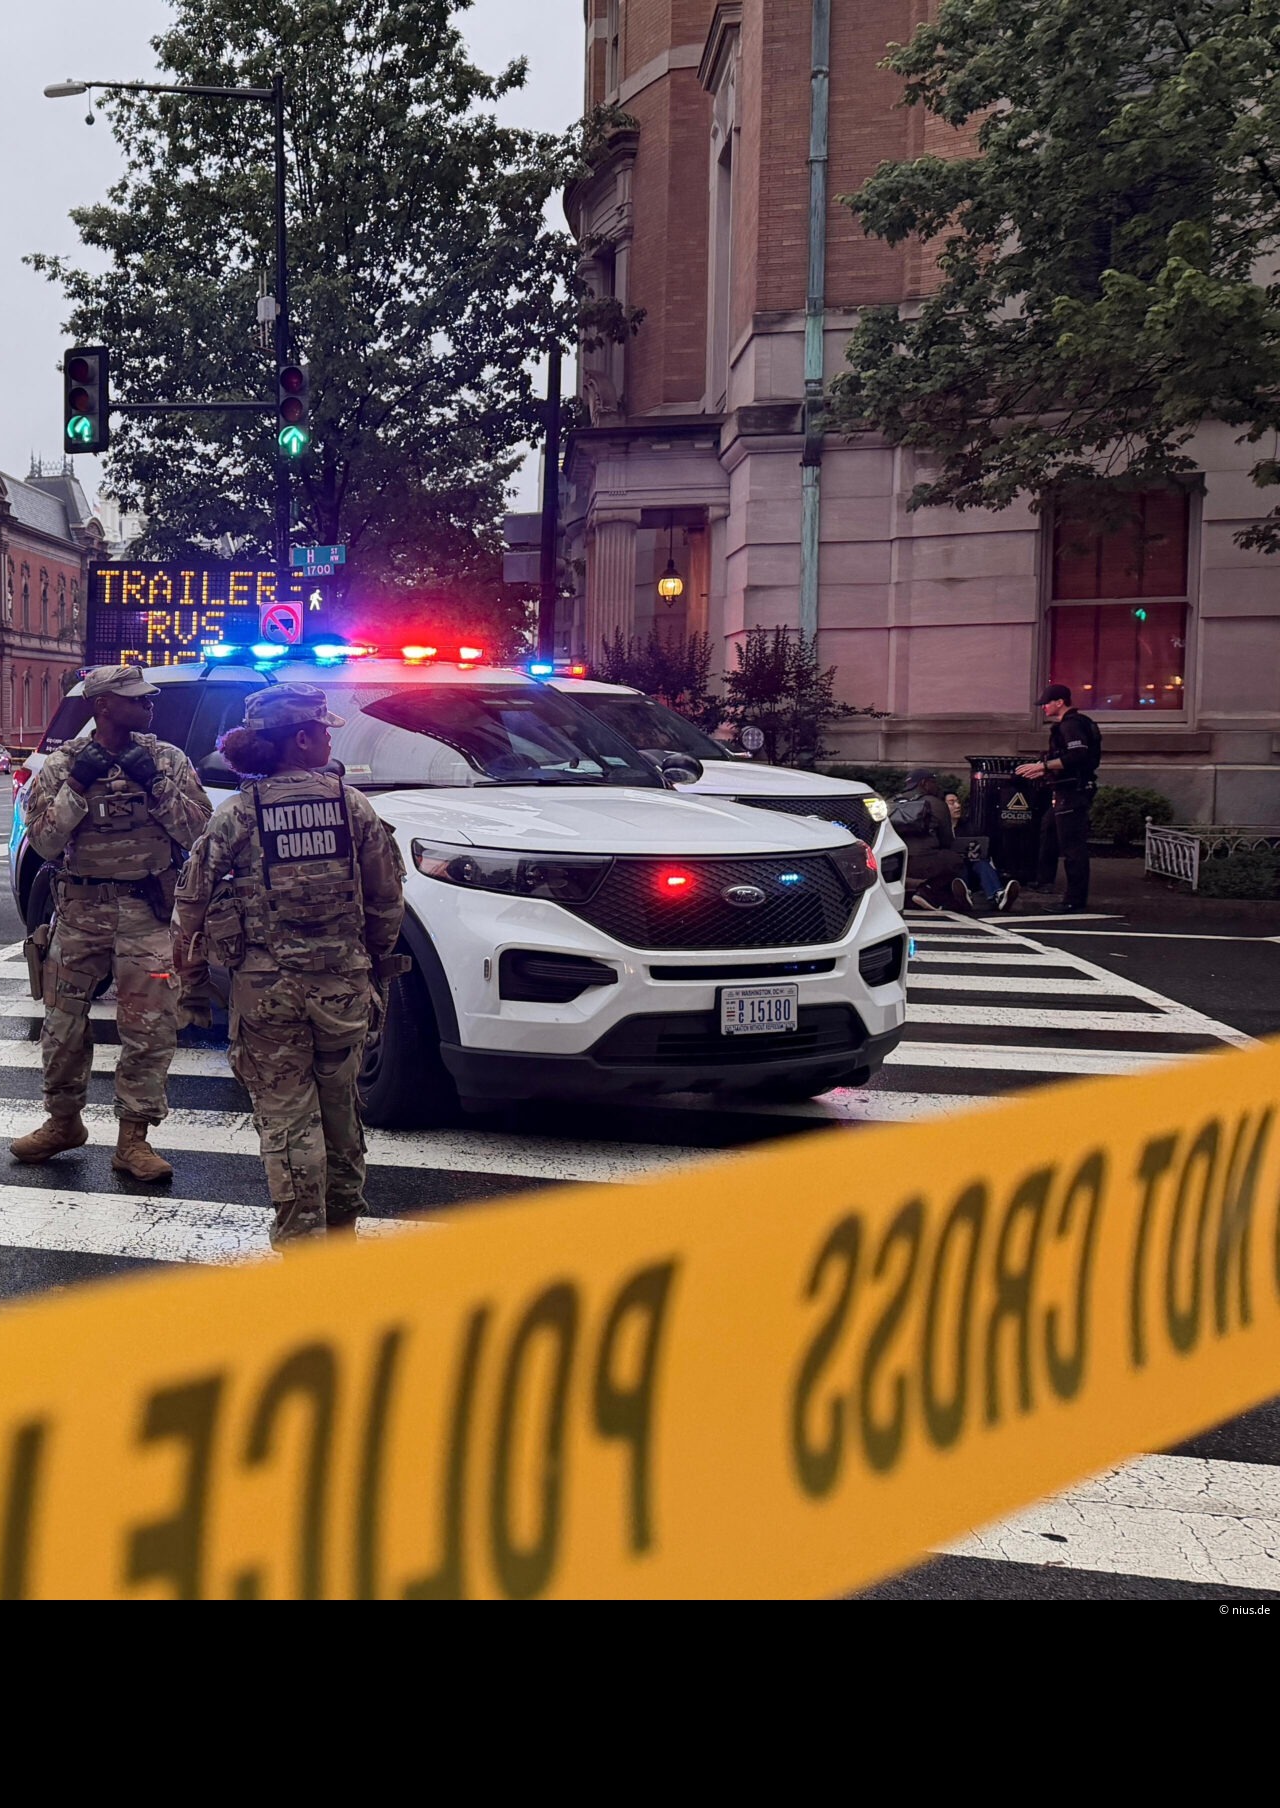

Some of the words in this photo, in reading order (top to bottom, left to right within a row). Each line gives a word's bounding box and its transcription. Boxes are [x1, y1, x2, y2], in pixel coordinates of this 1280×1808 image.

[307, 549, 315, 563] H
[330, 547, 338, 555] ST
[307, 564, 331, 576] 1700
[147, 611, 225, 645] RVS
[262, 802, 345, 832] NATIONAL
[276, 830, 337, 859] GUARD
[750, 998, 791, 1023] 15180
